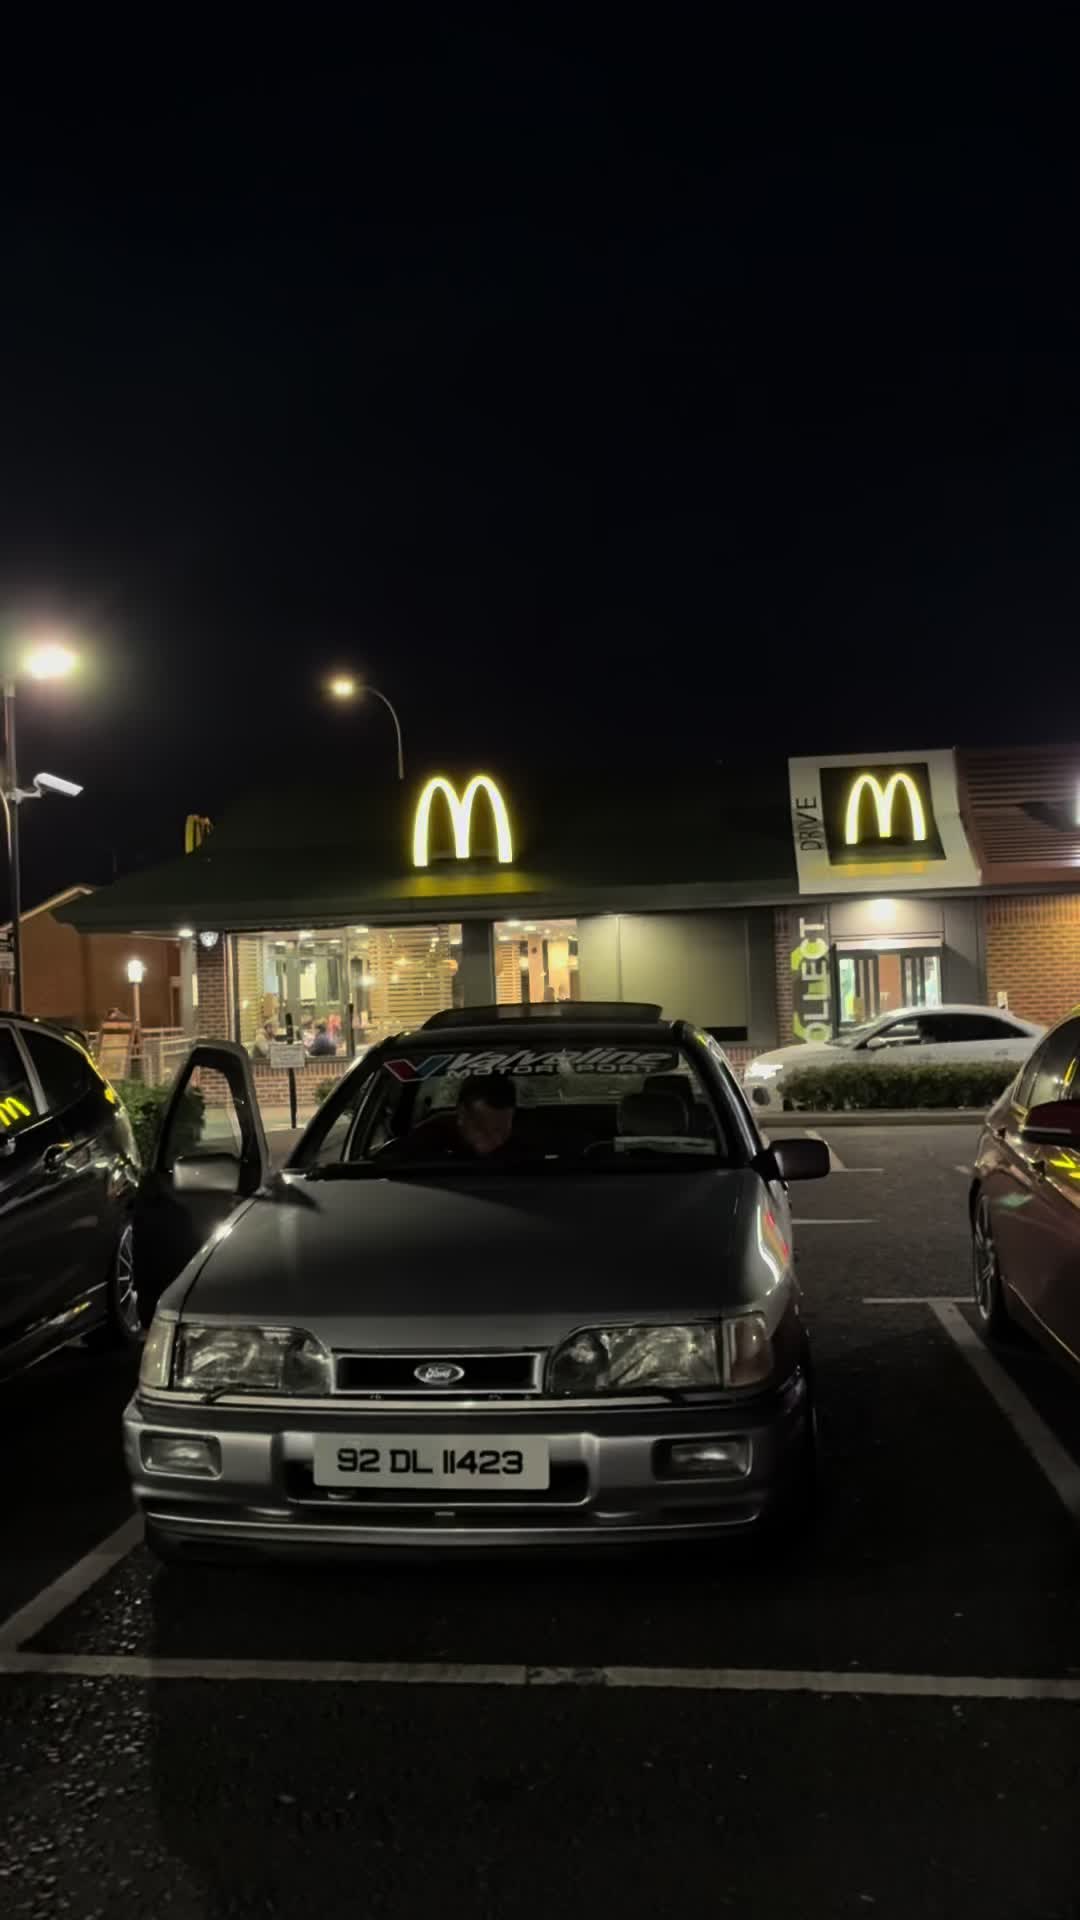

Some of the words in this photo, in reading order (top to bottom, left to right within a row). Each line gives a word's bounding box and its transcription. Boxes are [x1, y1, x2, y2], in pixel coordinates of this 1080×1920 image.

[795, 796, 822, 852] DRIVE
[799, 917, 832, 1044] OLLECT
[447, 1047, 673, 1070] Valvoline
[336, 1448, 381, 1473] 92
[389, 1449, 433, 1474] DL
[442, 1450, 524, 1475] 11423
